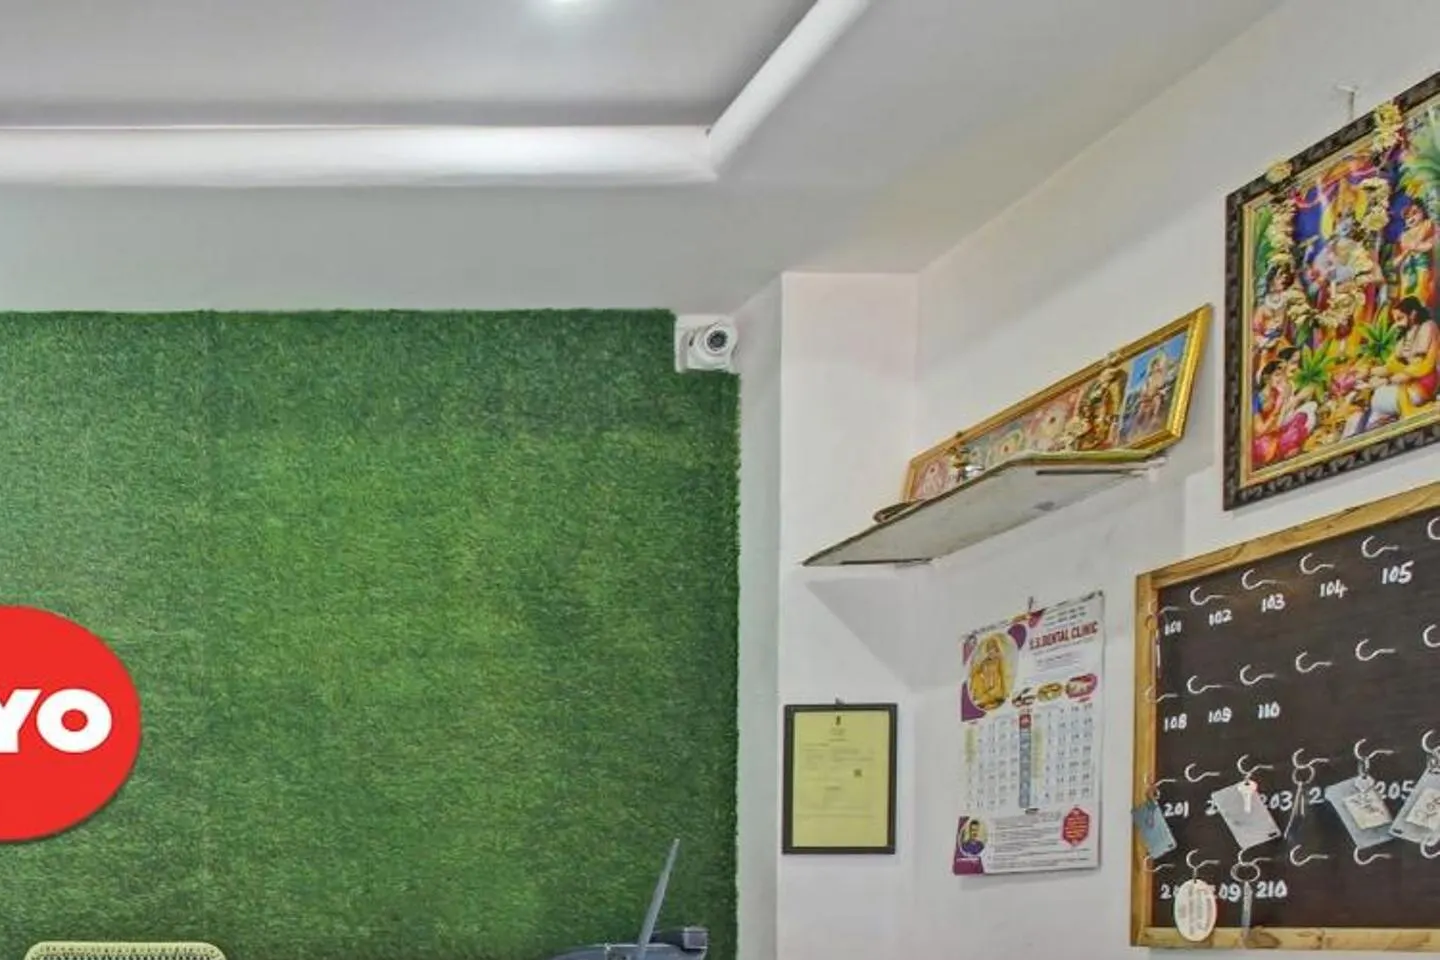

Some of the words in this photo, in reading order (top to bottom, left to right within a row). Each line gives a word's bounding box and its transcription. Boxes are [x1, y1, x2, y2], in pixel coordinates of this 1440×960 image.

[1164, 621, 1182, 635] 101
[1209, 609, 1232, 626] 102
[1261, 593, 1285, 612] 103
[1320, 579, 1348, 598] 104
[1382, 560, 1414, 584] 105
[1164, 714, 1187, 731] 108
[1209, 707, 1232, 723] 109
[1258, 701, 1280, 719] 110
[1164, 802, 1189, 818] 201
[1256, 880, 1288, 898] 210
